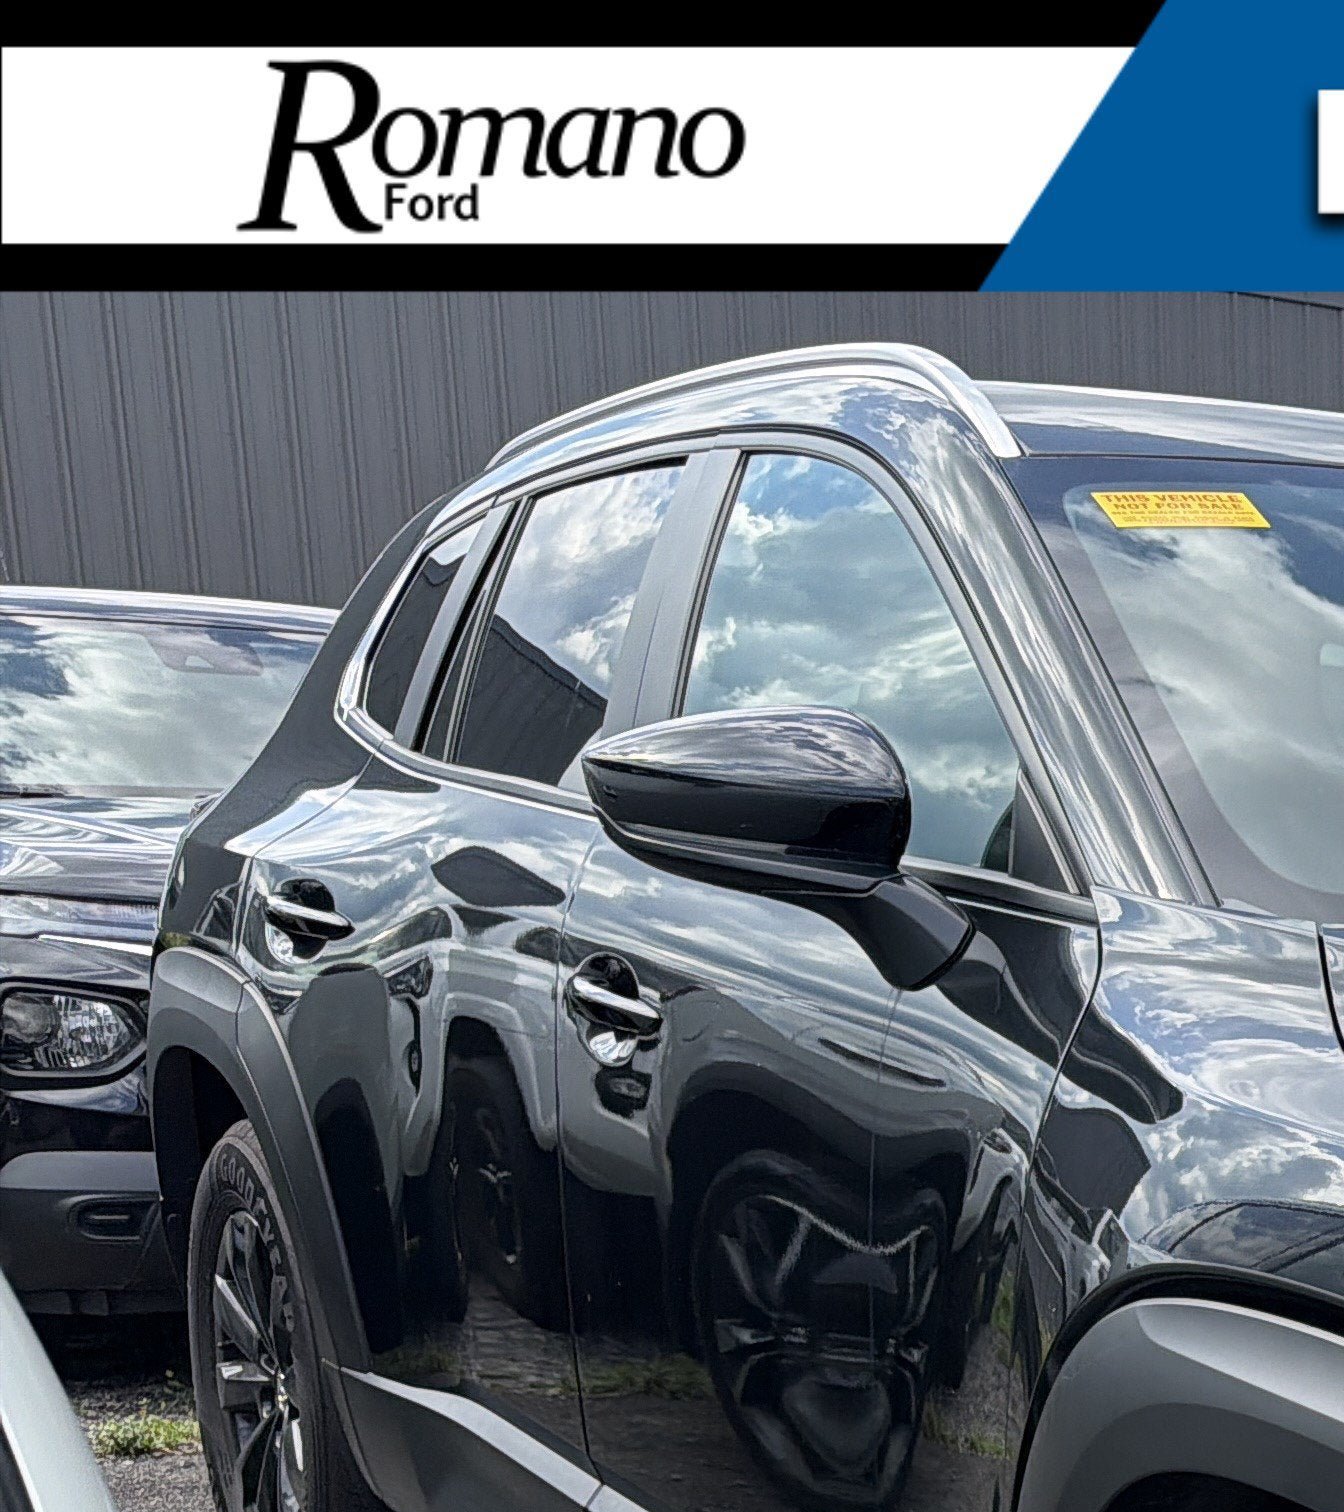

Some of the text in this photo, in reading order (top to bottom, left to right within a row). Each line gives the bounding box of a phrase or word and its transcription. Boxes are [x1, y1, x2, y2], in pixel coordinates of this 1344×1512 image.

[1101, 494, 1243, 504] THIS VEHICLE
[1113, 503, 1245, 511] NOT FOR SALE
